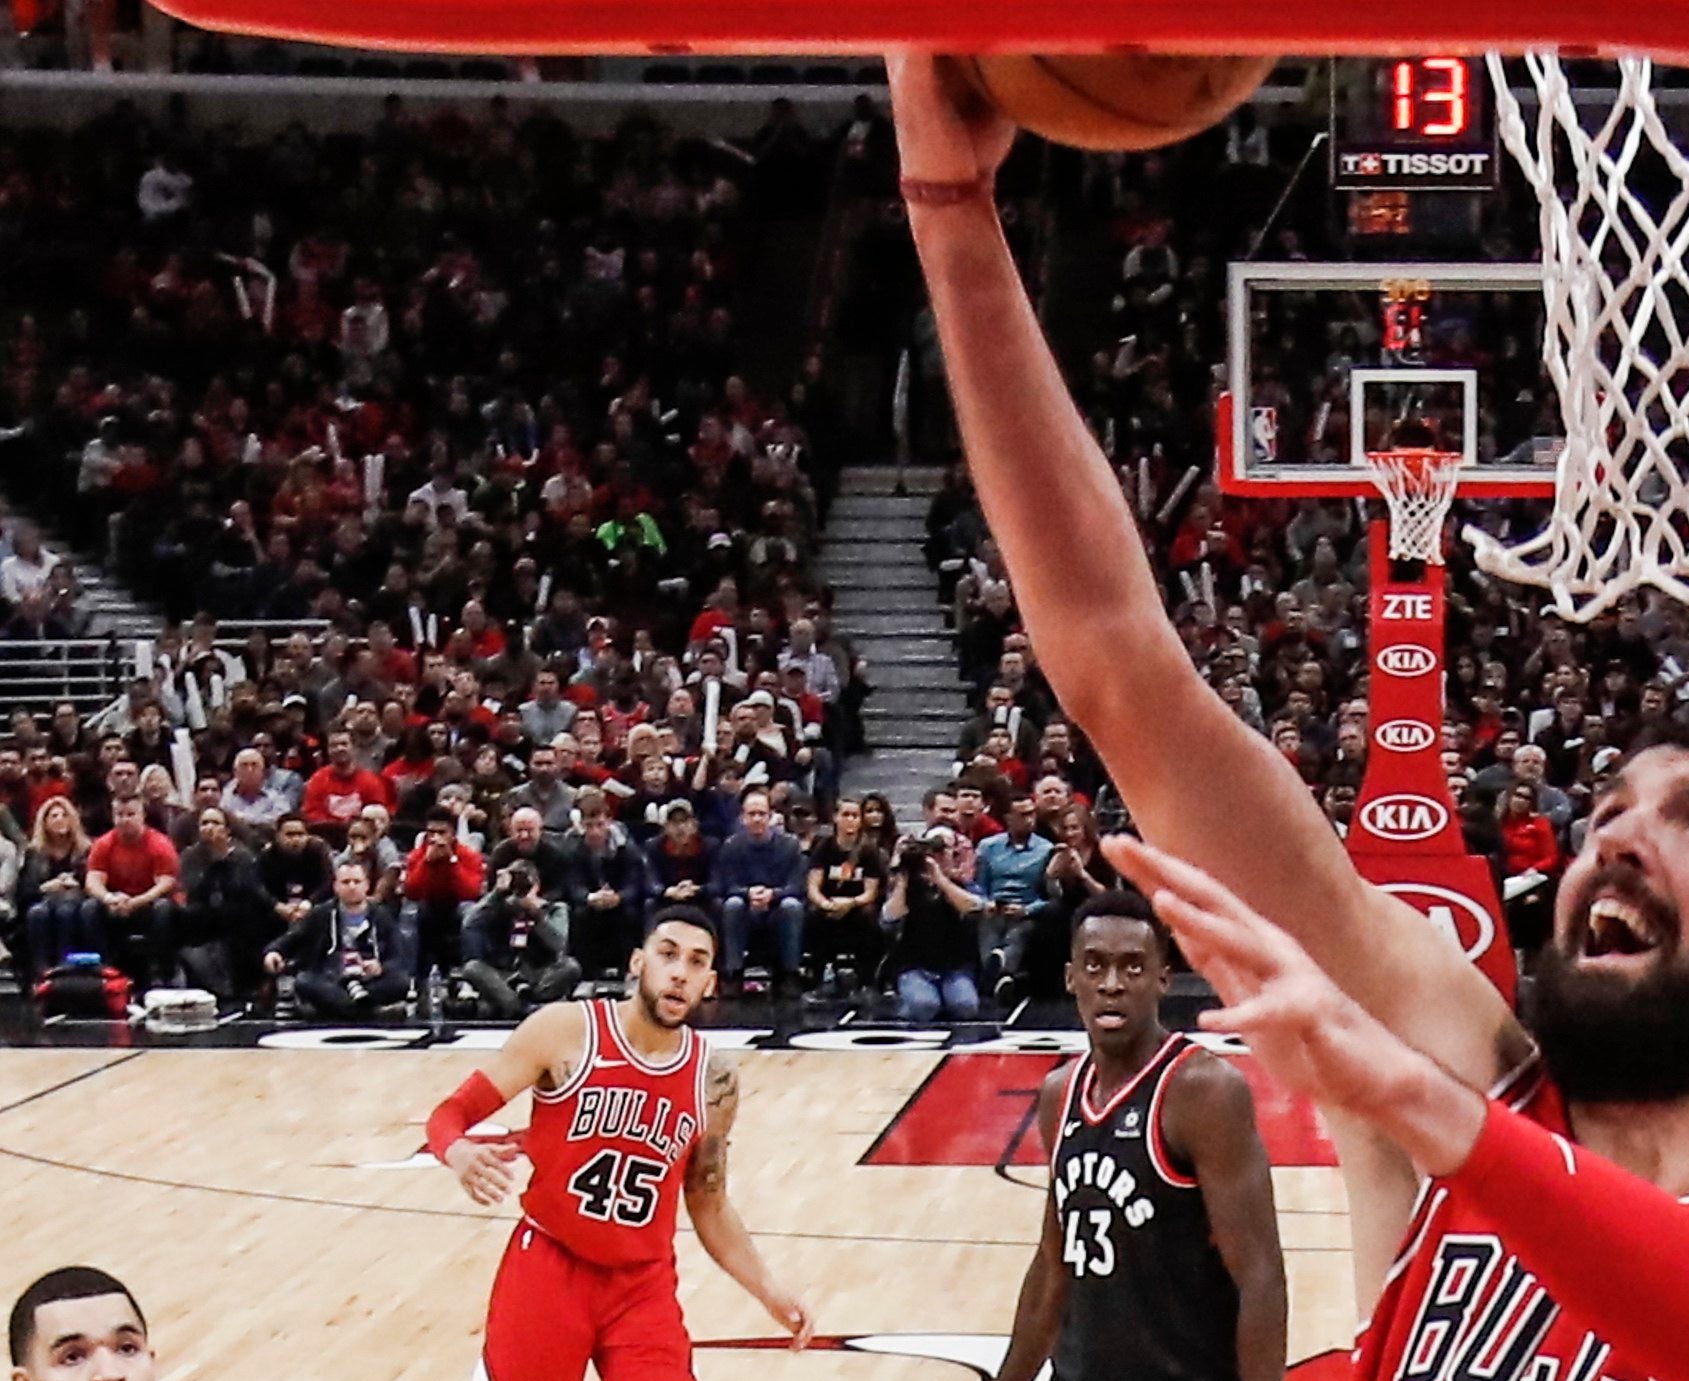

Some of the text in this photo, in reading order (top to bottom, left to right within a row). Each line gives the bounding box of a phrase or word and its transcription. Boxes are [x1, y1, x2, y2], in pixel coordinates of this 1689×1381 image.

[1393, 57, 1468, 137] 13
[1382, 153, 1489, 175] TISSOT
[1382, 594, 1433, 620] ZTE
[1387, 651, 1426, 670] KIA
[1386, 727, 1425, 746] KIA
[1376, 805, 1432, 830] KIA
[567, 1087, 697, 1167] BULLS
[567, 1148, 670, 1227] 45
[1055, 1152, 1155, 1227] APTORS
[1063, 1210, 1115, 1277] 43
